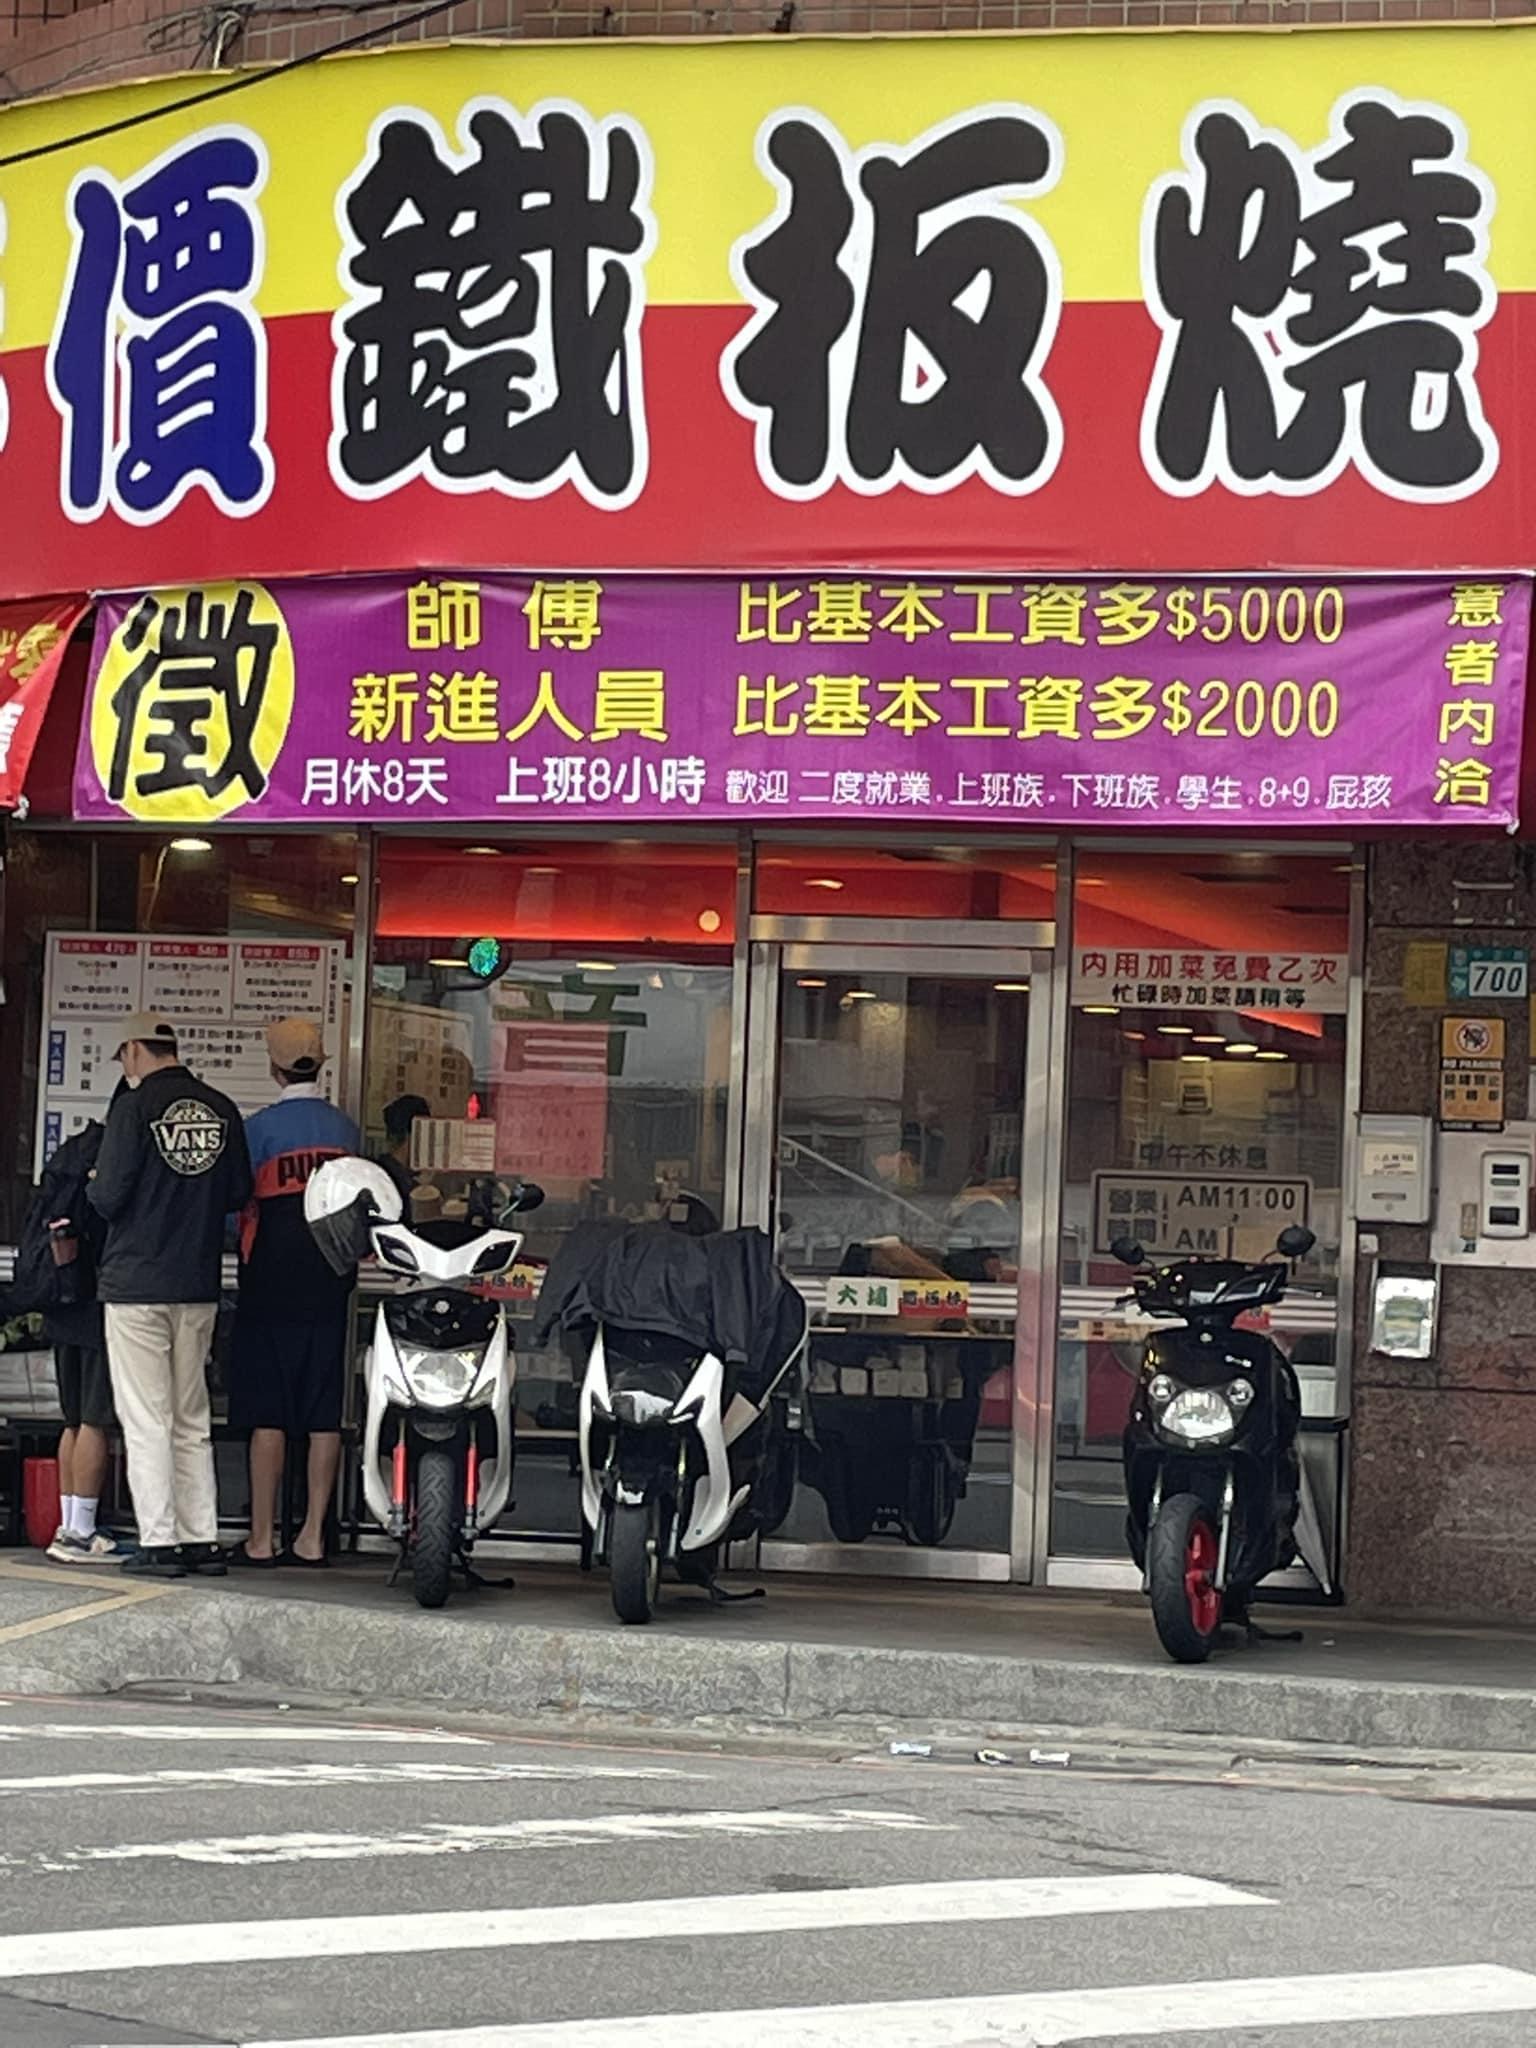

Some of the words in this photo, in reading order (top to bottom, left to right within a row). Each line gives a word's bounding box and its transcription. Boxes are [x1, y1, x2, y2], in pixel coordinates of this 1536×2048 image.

[407, 581, 603, 651] 師傅
[738, 583, 1345, 646] 比基本工資多$5000
[107, 588, 281, 802] 徵
[350, 671, 668, 744] 新進人員
[734, 675, 1339, 741] 比基本工資多$2000
[1434, 584, 1504, 806] 意者內洽
[302, 758, 449, 805] 月休8天
[496, 757, 706, 805] 上班8小時
[1081, 953, 1338, 984] 內用加菜免費乙次
[1474, 966, 1523, 993] 700
[159, 1123, 221, 1151] VANS
